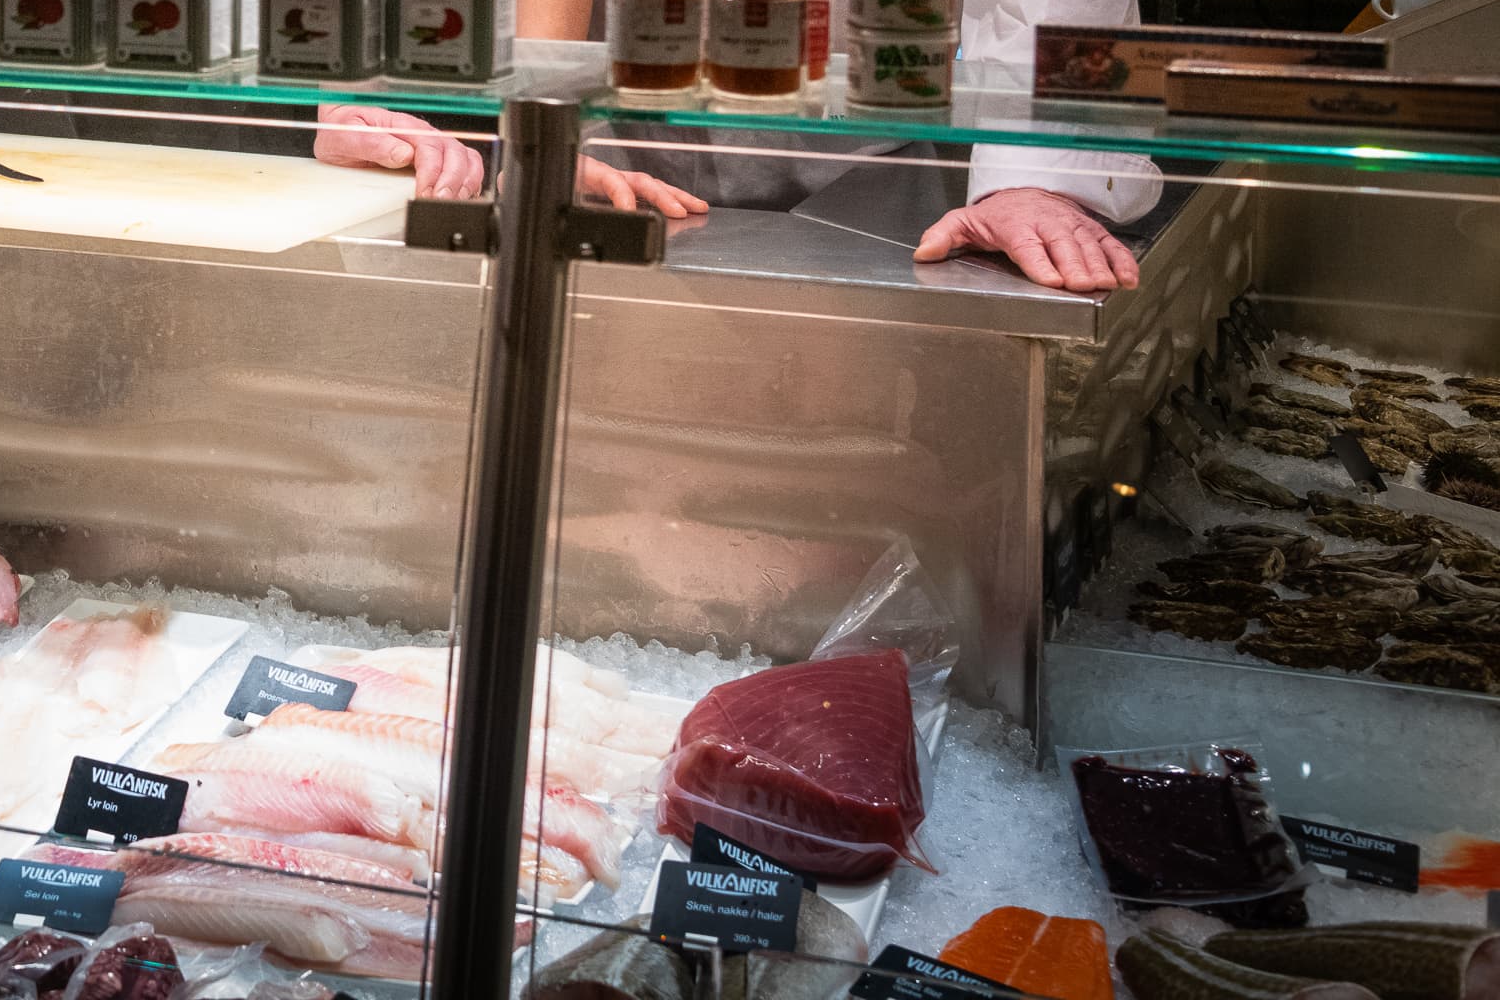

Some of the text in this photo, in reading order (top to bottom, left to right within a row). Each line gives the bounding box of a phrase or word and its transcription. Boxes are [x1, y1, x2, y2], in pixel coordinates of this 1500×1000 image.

[268, 666, 337, 696] VULKANFISK
[92, 767, 168, 800] VULKANFISK
[87, 797, 118, 813] Lyr loin
[1302, 824, 1396, 855] VULKANFISK
[718, 838, 794, 876] VULKANF
[21, 865, 103, 887] VULKANFISK
[686, 870, 779, 897] VULKANFISK
[24, 890, 59, 901] Sei loin
[717, 905, 749, 918] nakke
[757, 936, 769, 948] kg
